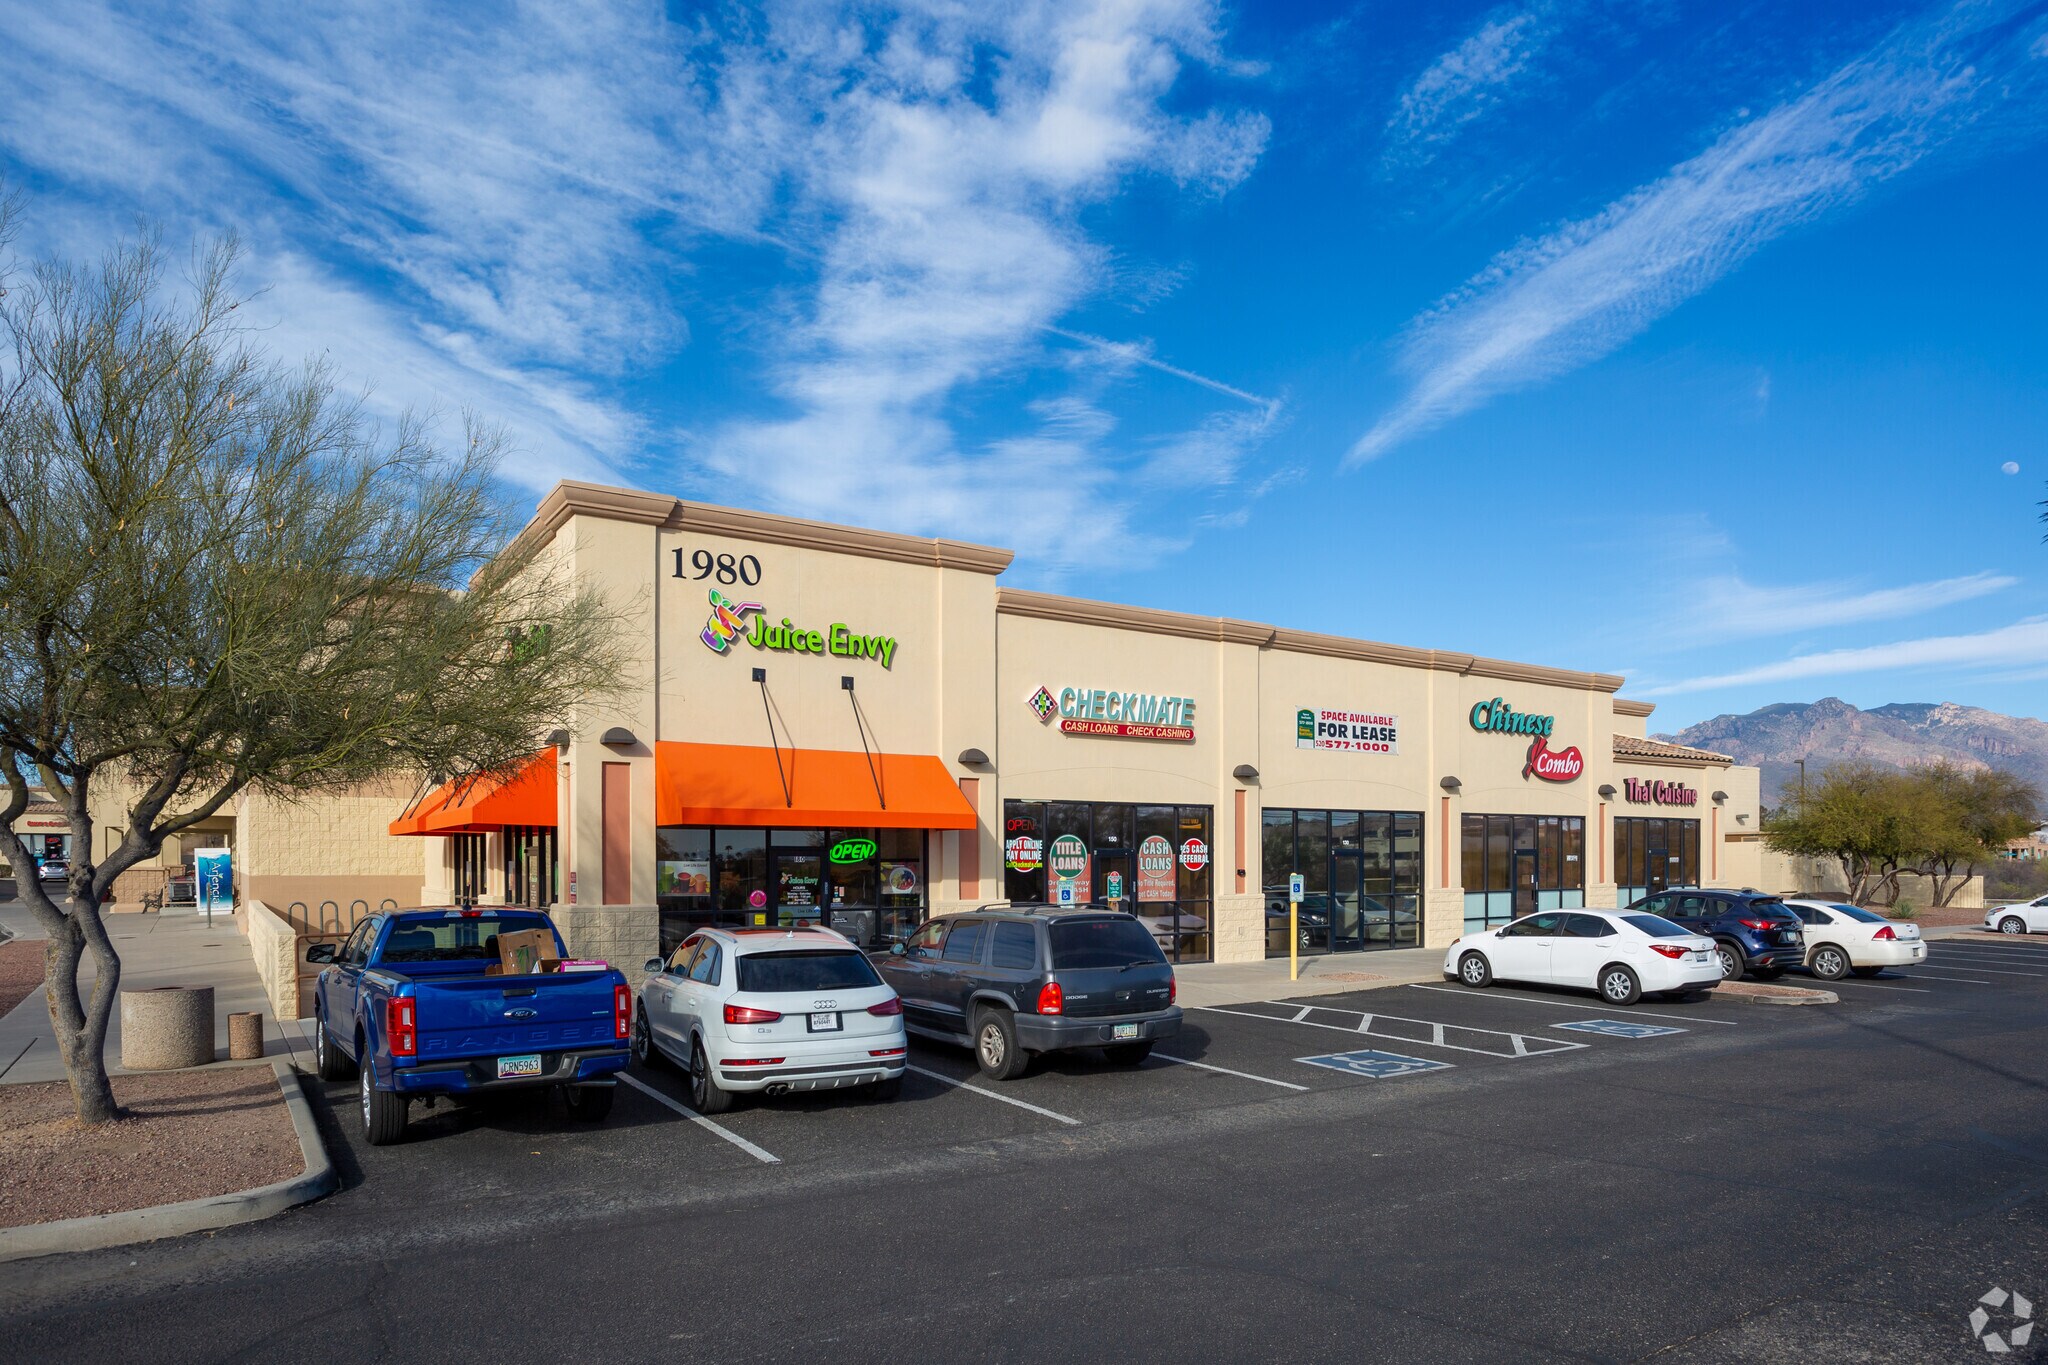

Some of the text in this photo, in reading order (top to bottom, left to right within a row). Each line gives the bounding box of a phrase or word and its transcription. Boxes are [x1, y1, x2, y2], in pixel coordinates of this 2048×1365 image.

[672, 547, 762, 586] 1980
[747, 614, 895, 667] Juice Envy
[1059, 687, 1194, 726] CHECKMATE
[1321, 711, 1393, 726] SPACE AVAILABLE
[1473, 697, 1555, 736] Chinese
[1064, 722, 1191, 739] CASH LOANS CHECK CASHING
[1317, 722, 1348, 738] FOR
[1352, 725, 1396, 742] LEASE
[1325, 740, 1389, 752] 577-1000
[1537, 751, 1580, 774] Combo
[1627, 777, 1697, 805] Thai Cuisine
[1007, 819, 1035, 831] OPEN
[831, 842, 871, 860] OPEN
[1006, 839, 1043, 850] APPLY ONLINE
[1056, 842, 1082, 855] TITLE
[1143, 842, 1169, 855] CASH
[1180, 844, 1208, 854] $25 CASH
[1006, 850, 1042, 860] PAY ONLINE
[1179, 854, 1210, 864] REFERRAL
[1053, 857, 1085, 870] LOANS
[1140, 857, 1172, 870] LOANS
[424, 1026, 611, 1051] RANGER
[503, 1059, 539, 1073] CRN5963
